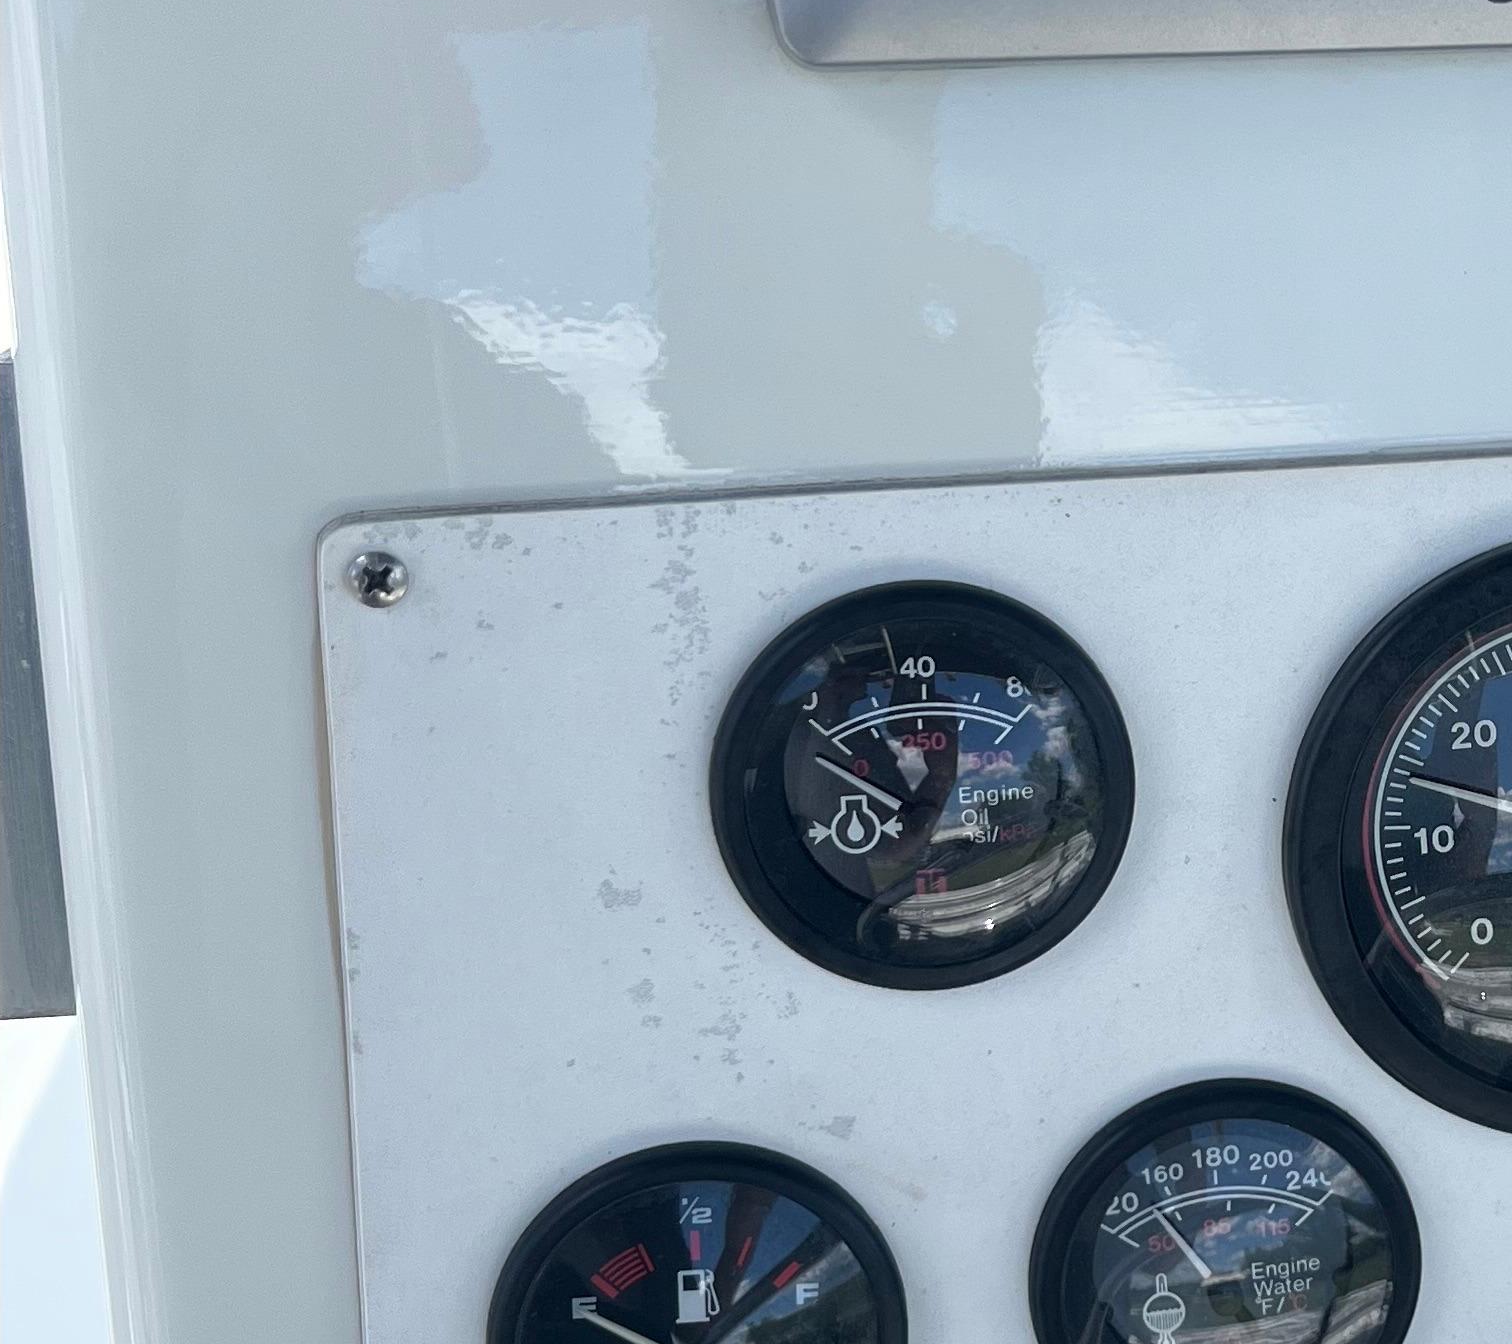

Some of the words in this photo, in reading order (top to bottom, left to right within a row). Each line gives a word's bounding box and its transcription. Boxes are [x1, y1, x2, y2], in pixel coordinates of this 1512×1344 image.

[899, 655, 936, 679] 40
[1006, 675, 1032, 699] 8
[902, 731, 947, 752] 250
[1450, 718, 1498, 751] 20
[958, 784, 1034, 806] Engine
[961, 807, 990, 827] Oil
[1413, 823, 1455, 856] 10
[1470, 917, 1495, 945] 0
[1141, 1163, 1184, 1185] 160
[1192, 1144, 1240, 1169] 180
[1249, 1149, 1293, 1171] 200
[1251, 1256, 1321, 1280] Engine
[795, 1282, 820, 1306] F
[1253, 1275, 1314, 1299] Water
[572, 1296, 598, 1321] E
